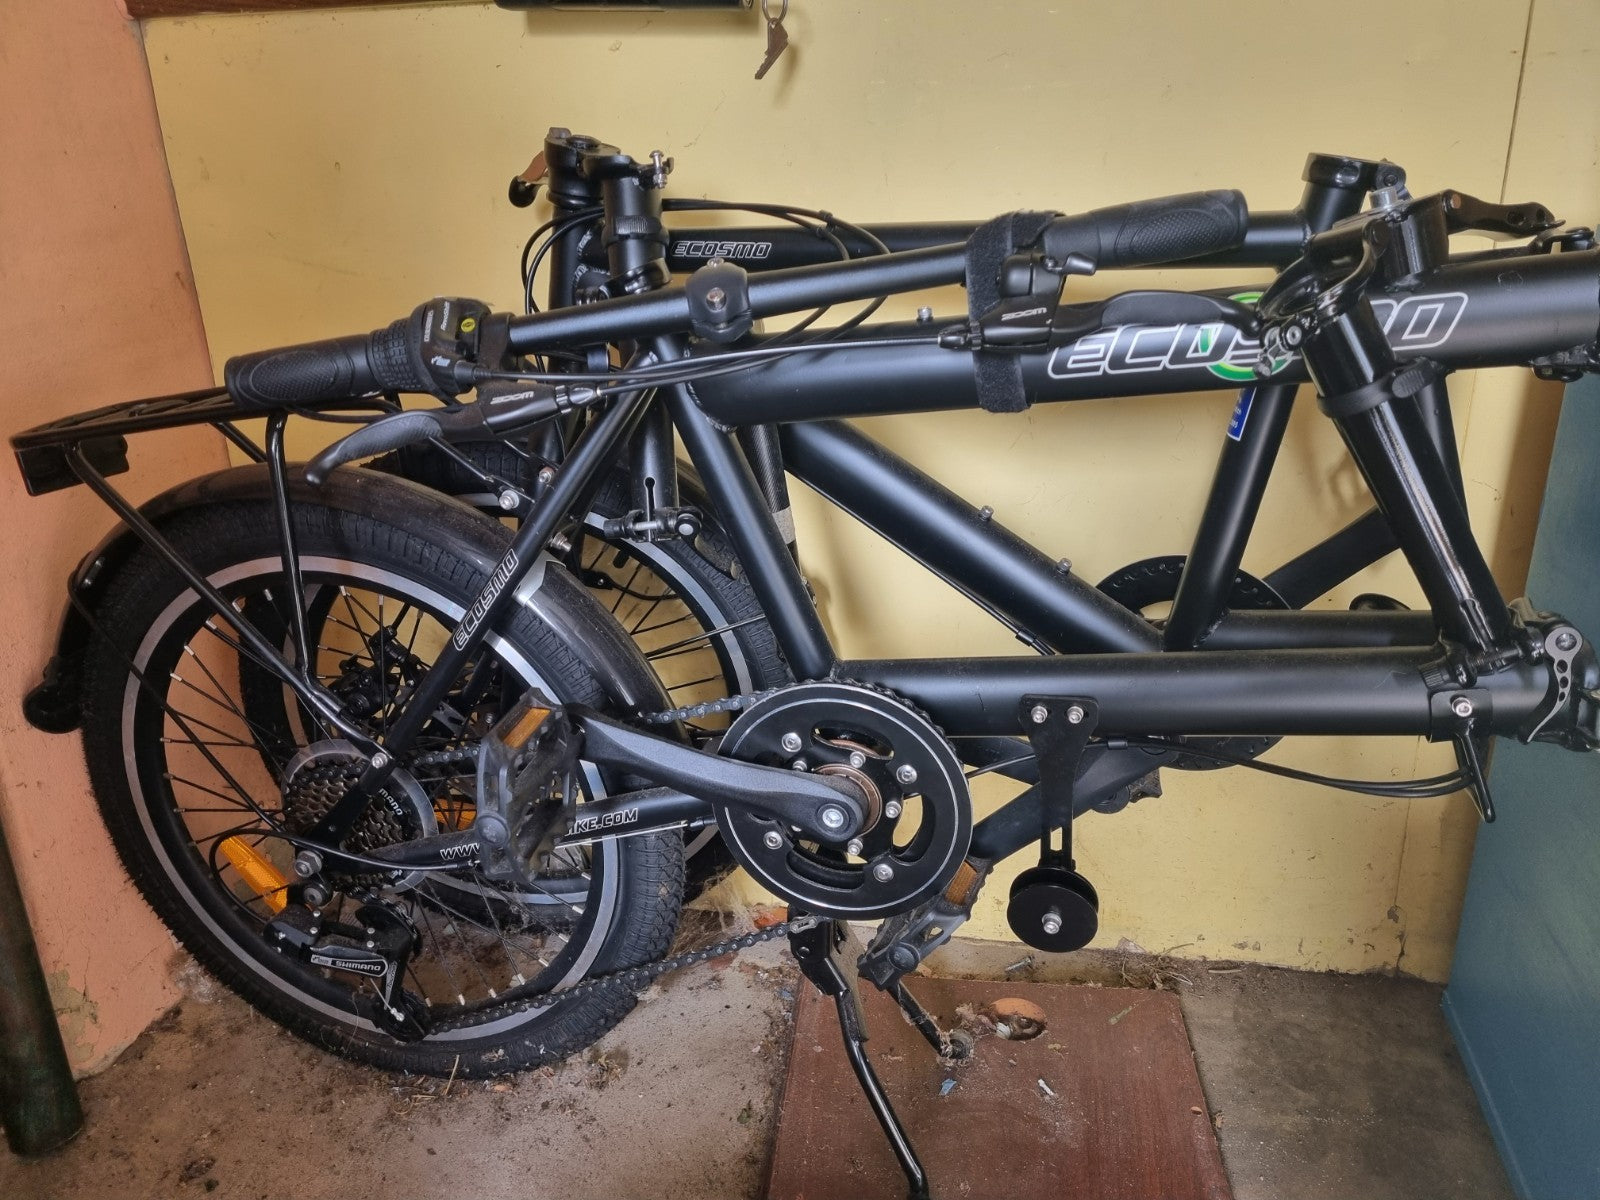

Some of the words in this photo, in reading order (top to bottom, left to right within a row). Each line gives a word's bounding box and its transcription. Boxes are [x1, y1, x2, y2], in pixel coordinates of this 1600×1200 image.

[672, 240, 772, 259] ECOSMO
[1047, 291, 1469, 379] ECOO
[452, 548, 519, 651] ECOSMO
[379, 787, 404, 816] MANO
[335, 960, 381, 971] SHIMANO
